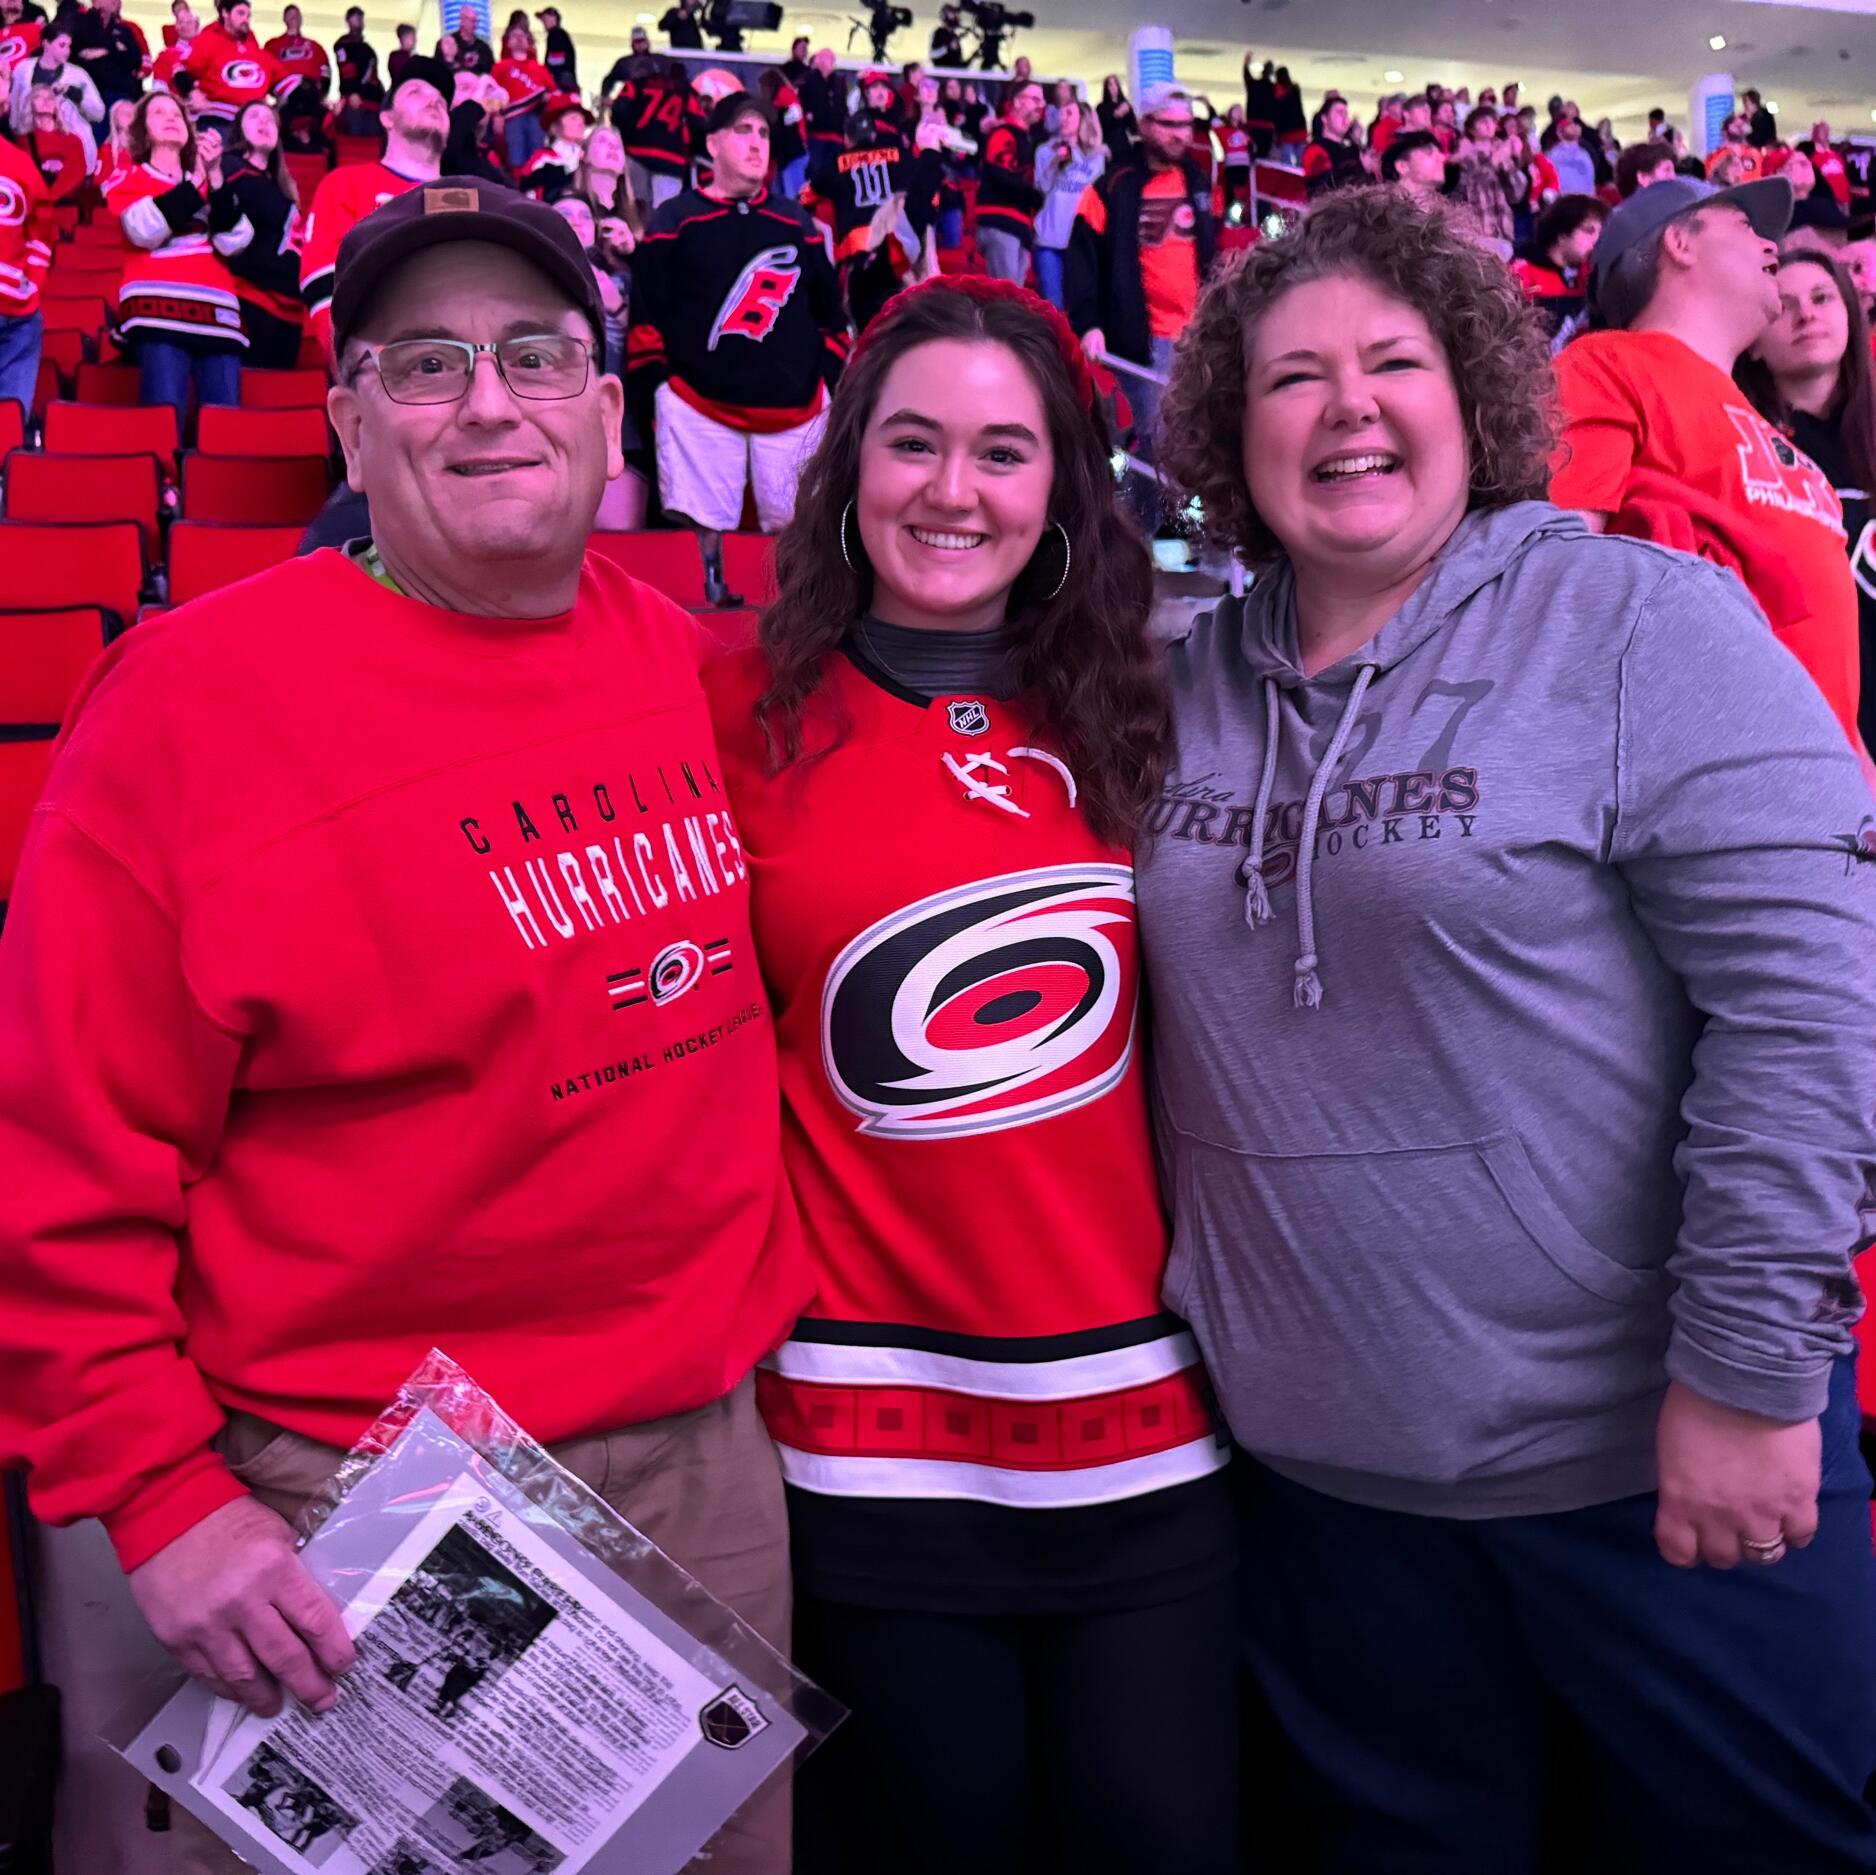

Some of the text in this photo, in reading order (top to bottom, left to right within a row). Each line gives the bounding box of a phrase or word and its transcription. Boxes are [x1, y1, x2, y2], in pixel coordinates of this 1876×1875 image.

[635, 87, 682, 133] 74
[959, 709, 980, 729] NHL
[488, 810, 747, 950] HURRICANES
[550, 1052, 656, 1102] NATIONAL
[662, 1024, 725, 1064] HOCKEY
